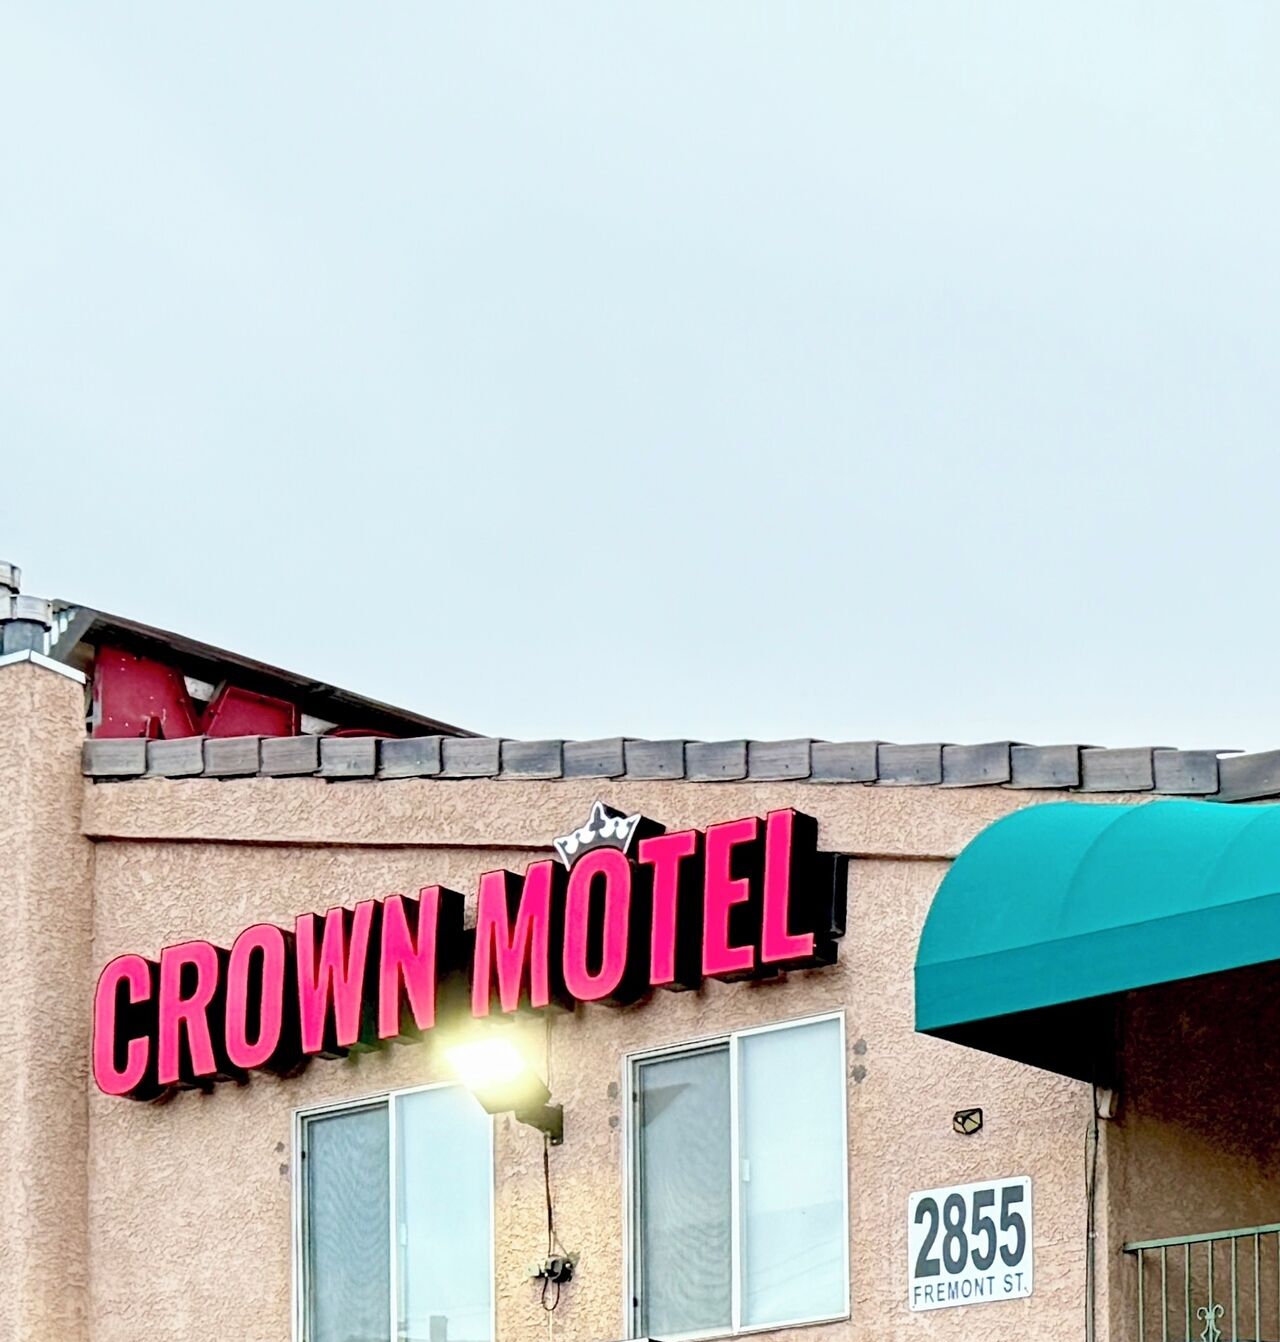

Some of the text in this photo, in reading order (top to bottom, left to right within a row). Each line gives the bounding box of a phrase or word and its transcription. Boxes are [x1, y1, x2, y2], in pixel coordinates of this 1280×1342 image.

[92, 806, 816, 1096] CROWN MOTEL
[914, 1185, 1026, 1279] 2855
[913, 1276, 996, 1305] FREMONT
